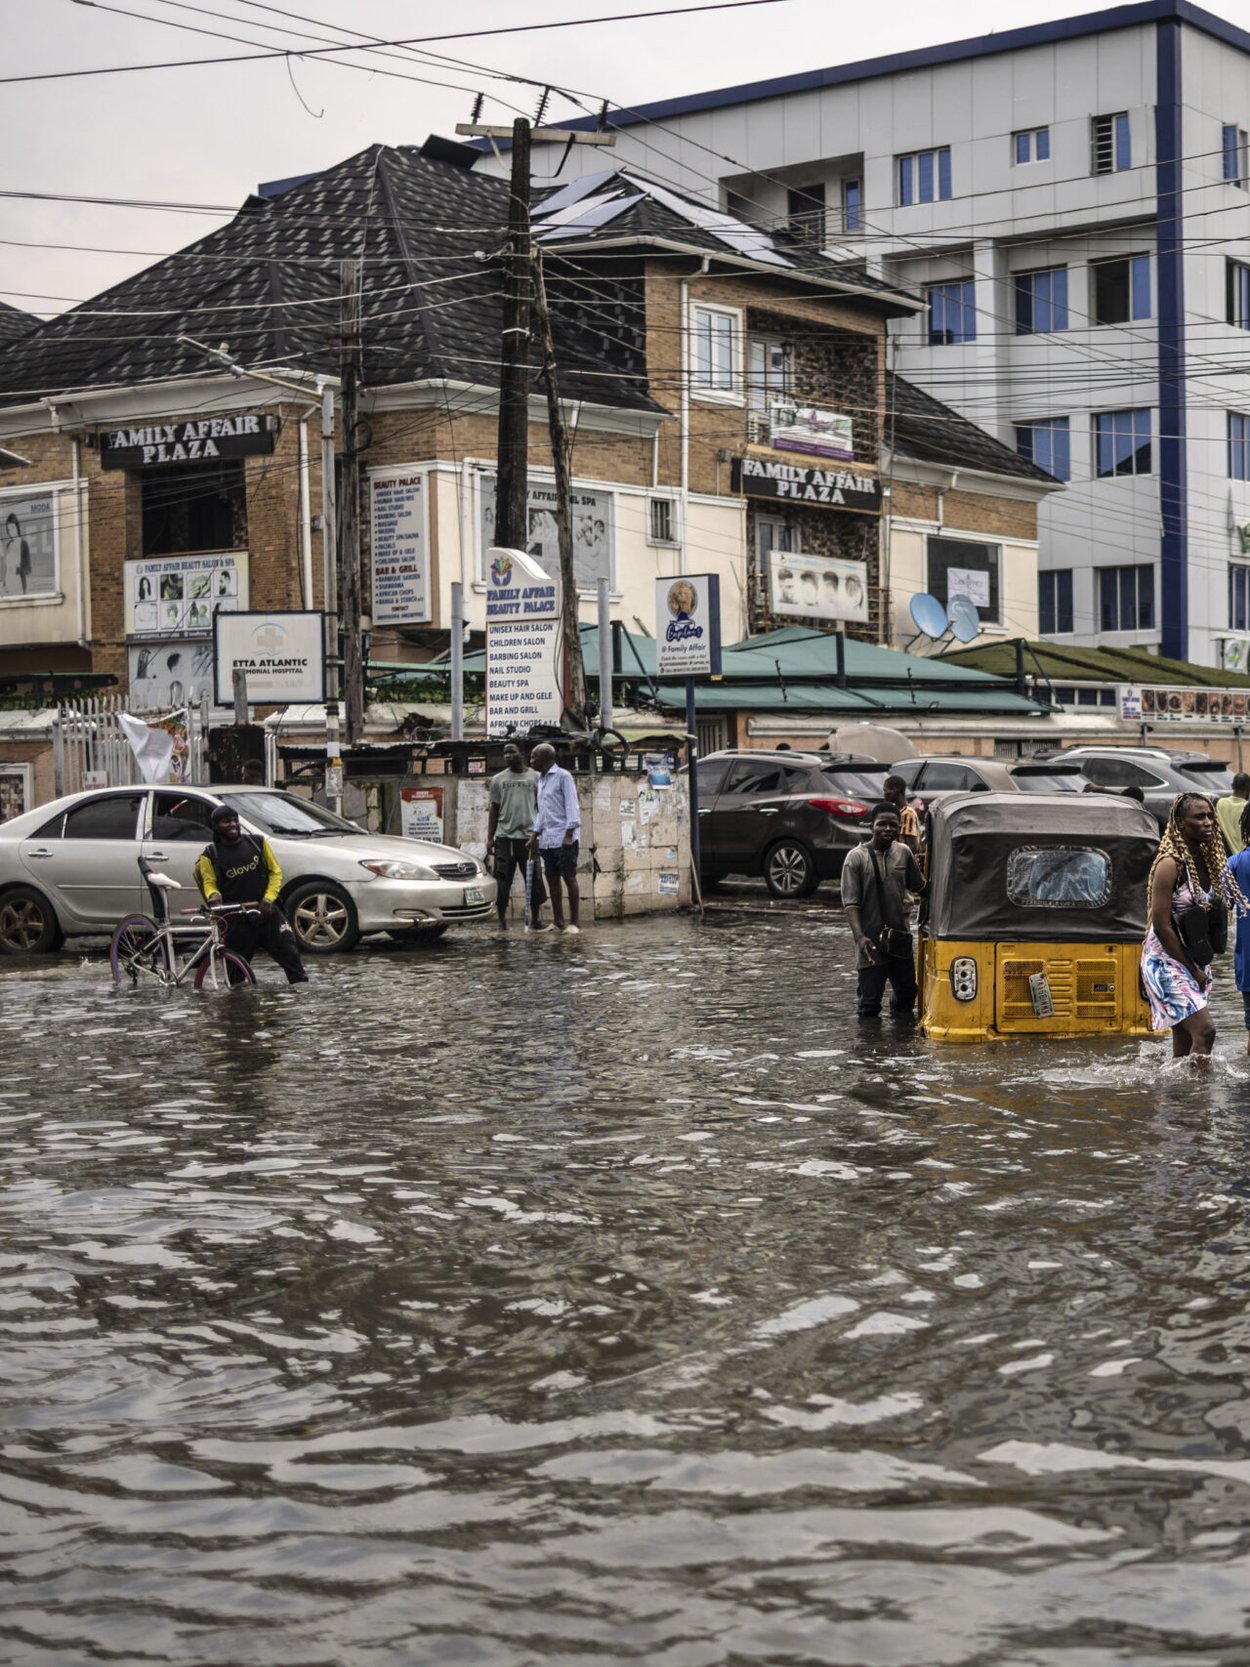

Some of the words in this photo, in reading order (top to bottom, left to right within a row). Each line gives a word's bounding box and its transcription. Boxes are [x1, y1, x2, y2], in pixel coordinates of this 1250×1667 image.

[108, 424, 179, 449] FAMILY
[182, 415, 261, 441] AFFAIR
[142, 439, 220, 464] PLAZA
[743, 459, 809, 483] FAMILY
[811, 470, 876, 494] AFFAIR
[374, 480, 397, 490] BEAUTY
[399, 476, 421, 487] PALACE
[776, 480, 845, 505] PLAZA
[581, 496, 596, 507] SPA
[144, 563, 162, 574] FAMILY
[162, 562, 180, 572] AFFAIR
[181, 560, 201, 571] BEAUTY
[375, 566, 389, 576] BAR
[391, 566, 397, 574] &
[399, 564, 418, 574] GRILL
[487, 588, 521, 602] FAMILY
[522, 586, 555, 599] AFFAIR
[487, 602, 521, 616] BEAUTY
[523, 600, 555, 613] PALACE
[489, 625, 513, 634] UNISEX
[513, 624, 530, 633] HAIR
[531, 623, 553, 632] SALON
[489, 638, 522, 647] CHILDREN
[523, 637, 545, 646] SALON
[667, 644, 688, 653] Family
[688, 643, 706, 651] Affair
[489, 652, 519, 661] BARBING
[520, 651, 542, 660] SALON
[232, 659, 257, 668] ETTA
[258, 658, 307, 668] ATLANTIC
[489, 666, 504, 675] NAIL
[506, 665, 531, 674] STUDIO
[489, 680, 515, 688] BEAUTY
[516, 679, 529, 687] SPA
[489, 693, 509, 702] MAKE
[510, 693, 519, 701] UP
[520, 692, 535, 700] AND
[536, 692, 552, 700] GELE
[489, 707, 503, 715] BAR
[504, 706, 519, 714] AND
[520, 706, 539, 714] GRILL
[489, 720, 519, 728] AFRICAN
[519, 719, 542, 727] CHOPS
[226, 860, 257, 879] Glovo
